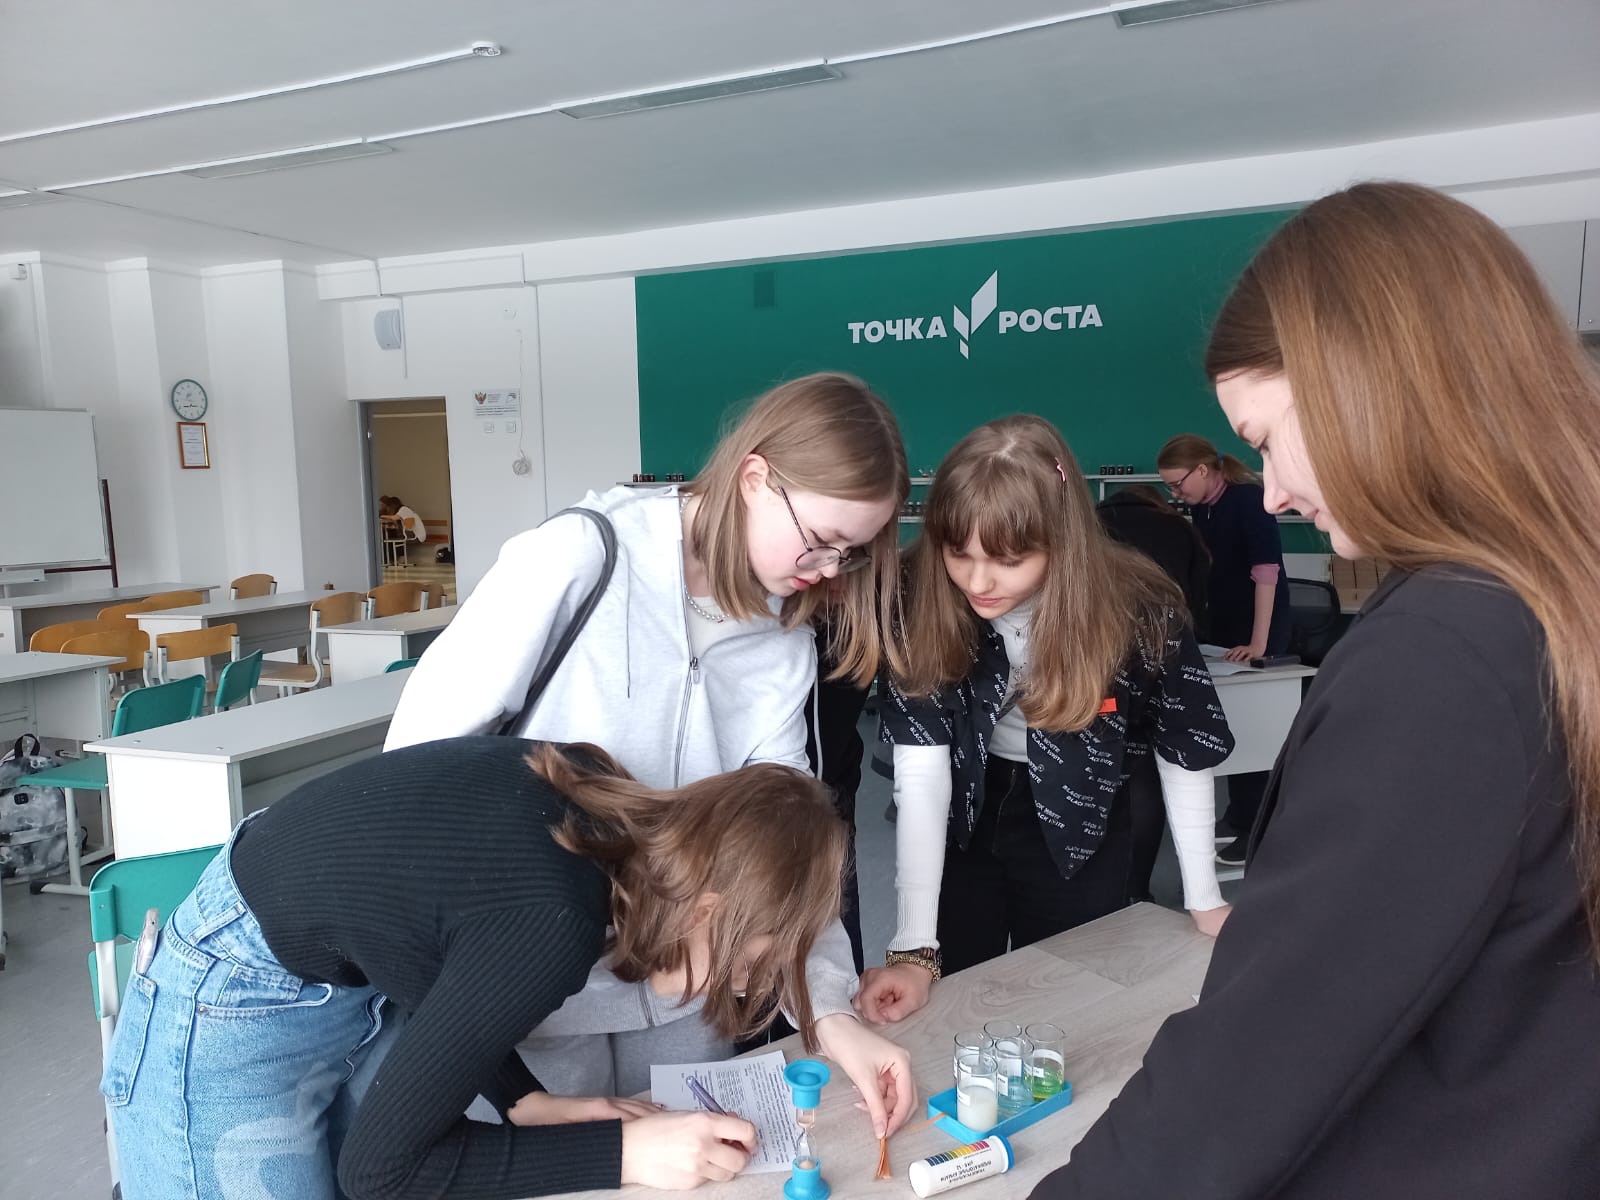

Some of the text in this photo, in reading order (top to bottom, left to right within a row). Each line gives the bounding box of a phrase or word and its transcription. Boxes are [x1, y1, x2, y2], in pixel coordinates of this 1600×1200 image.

[848, 304, 1103, 344] ТОЧКА РОСТА
[910, 726, 925, 744] BLACK
[1194, 736, 1213, 749] BLACK
[1032, 733, 1064, 764] BLACK WHITE
